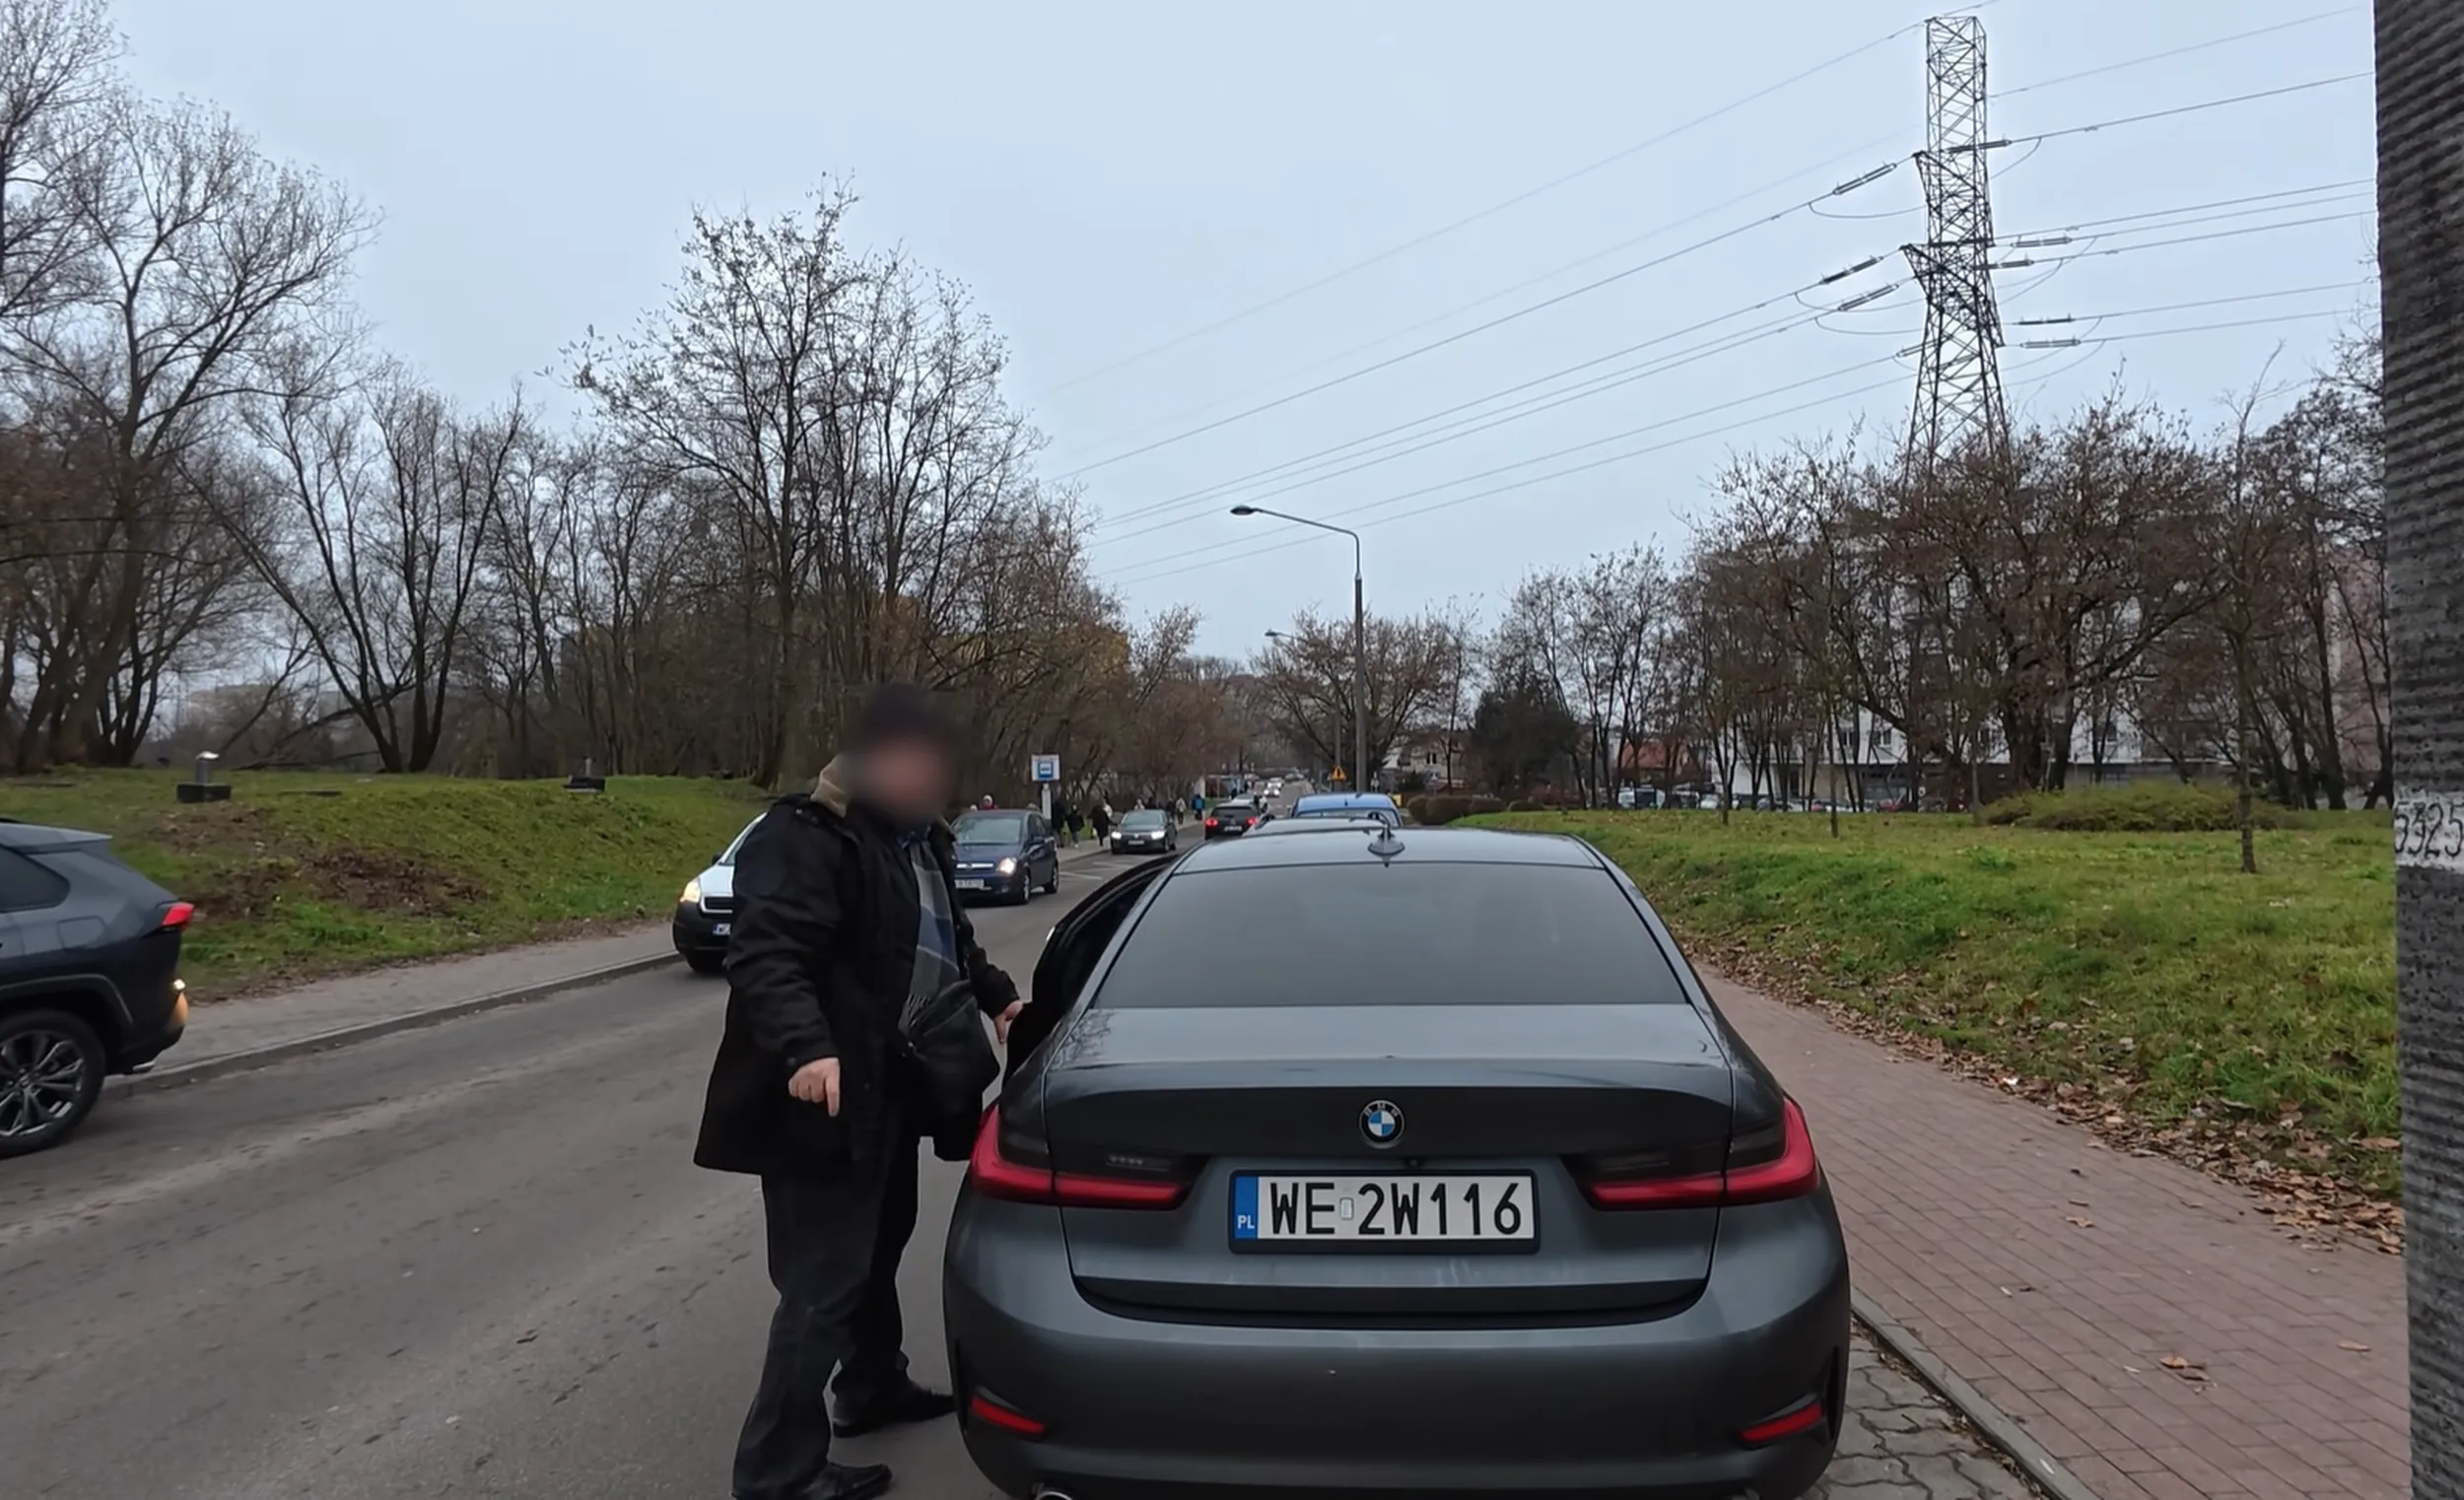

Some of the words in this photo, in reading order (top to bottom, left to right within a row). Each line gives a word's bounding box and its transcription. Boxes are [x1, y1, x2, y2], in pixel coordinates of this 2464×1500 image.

[1237, 1215, 1255, 1229] PL
[1269, 1183, 1335, 1234] WE
[1358, 1183, 1521, 1235] 2W116
